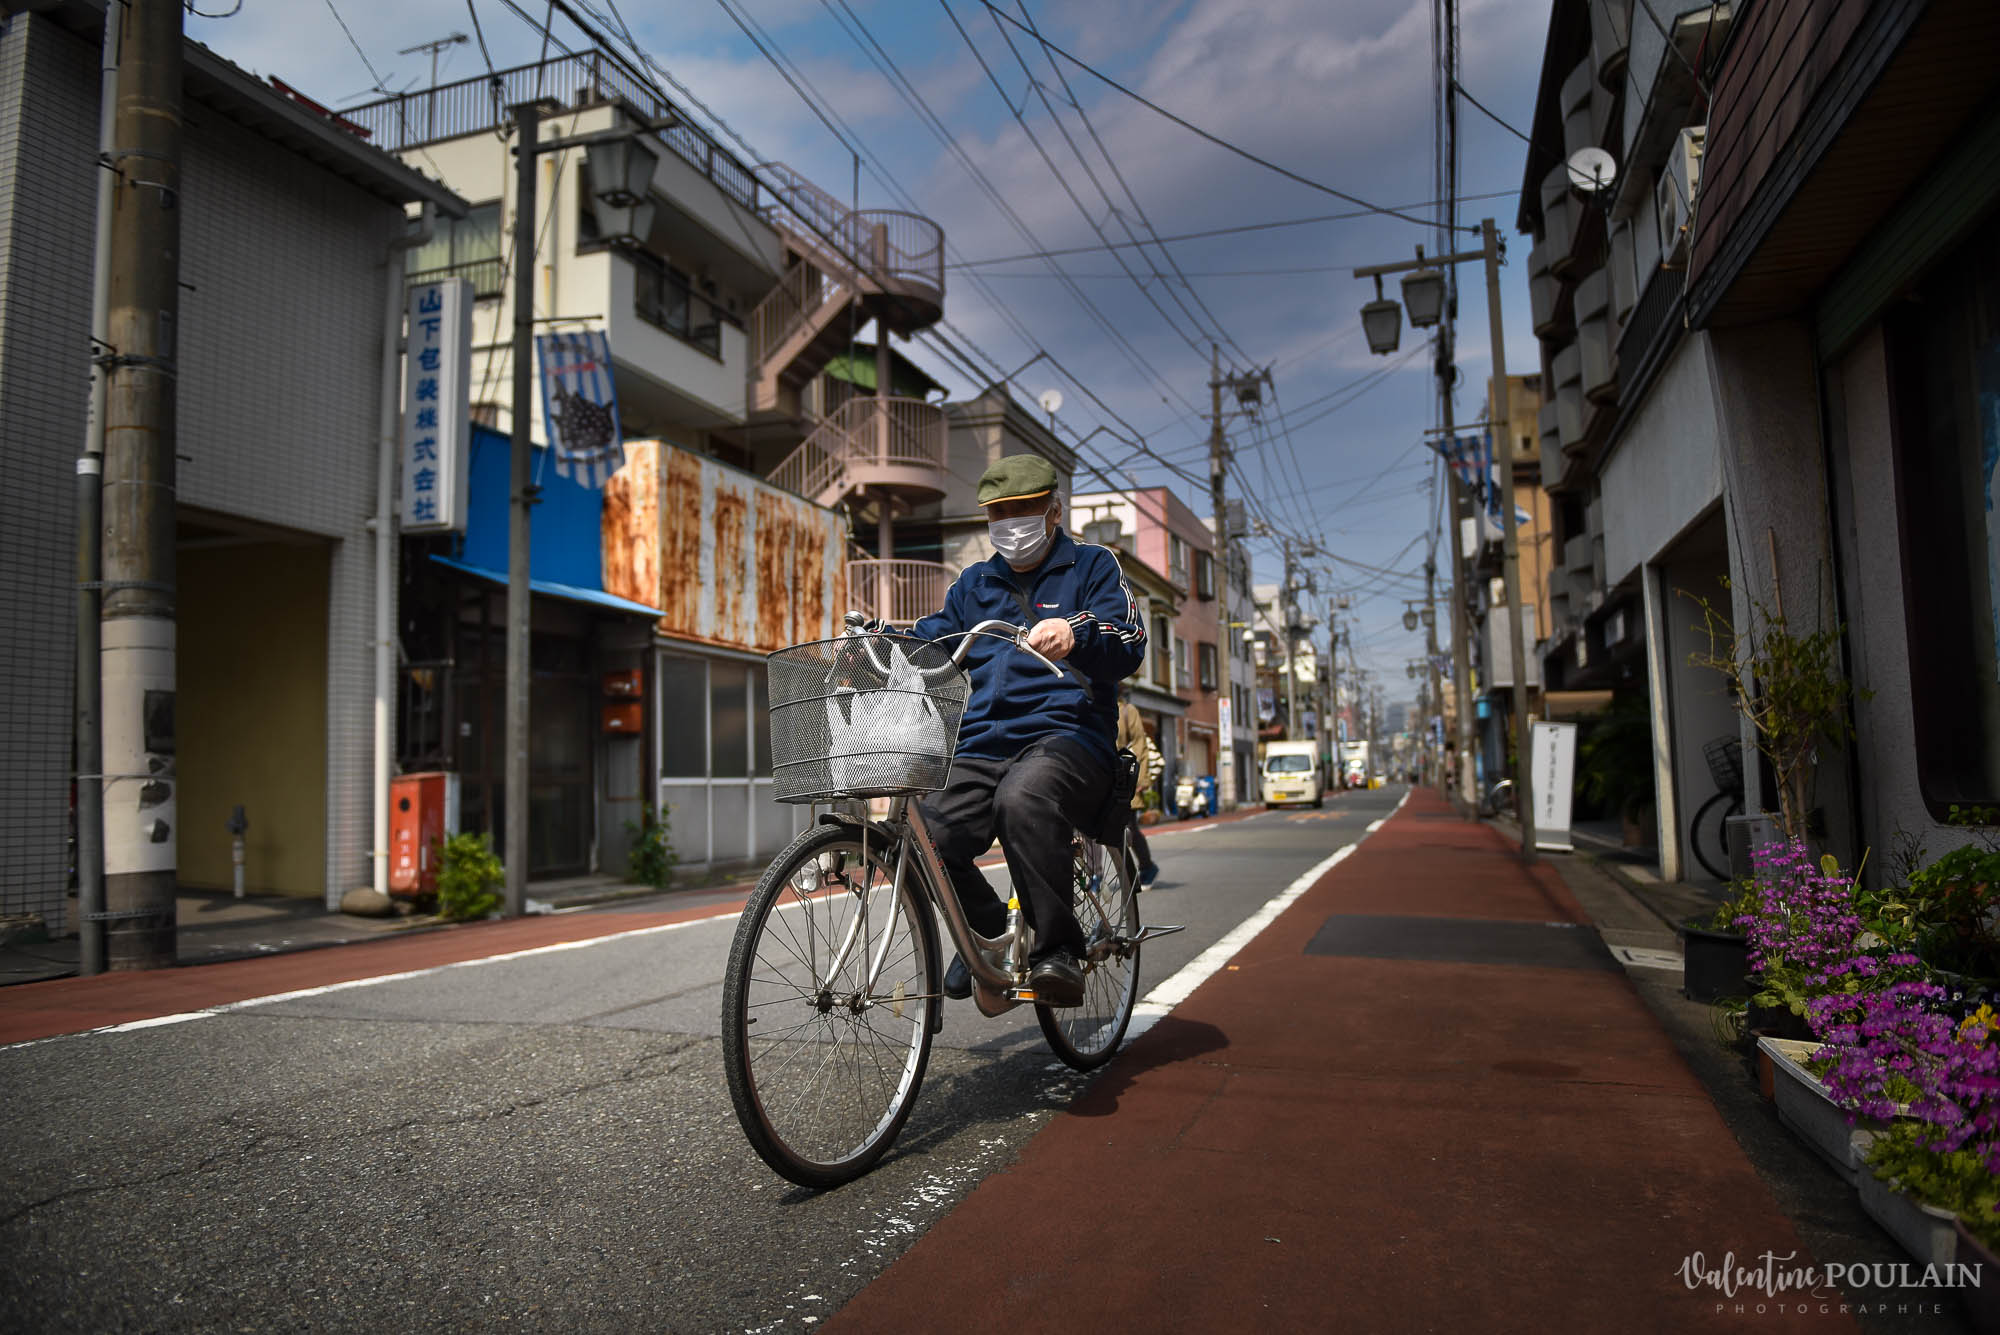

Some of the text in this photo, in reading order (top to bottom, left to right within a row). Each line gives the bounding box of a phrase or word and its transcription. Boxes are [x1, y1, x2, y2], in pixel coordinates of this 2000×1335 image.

[412, 289, 442, 521] 山下包装株式会社
